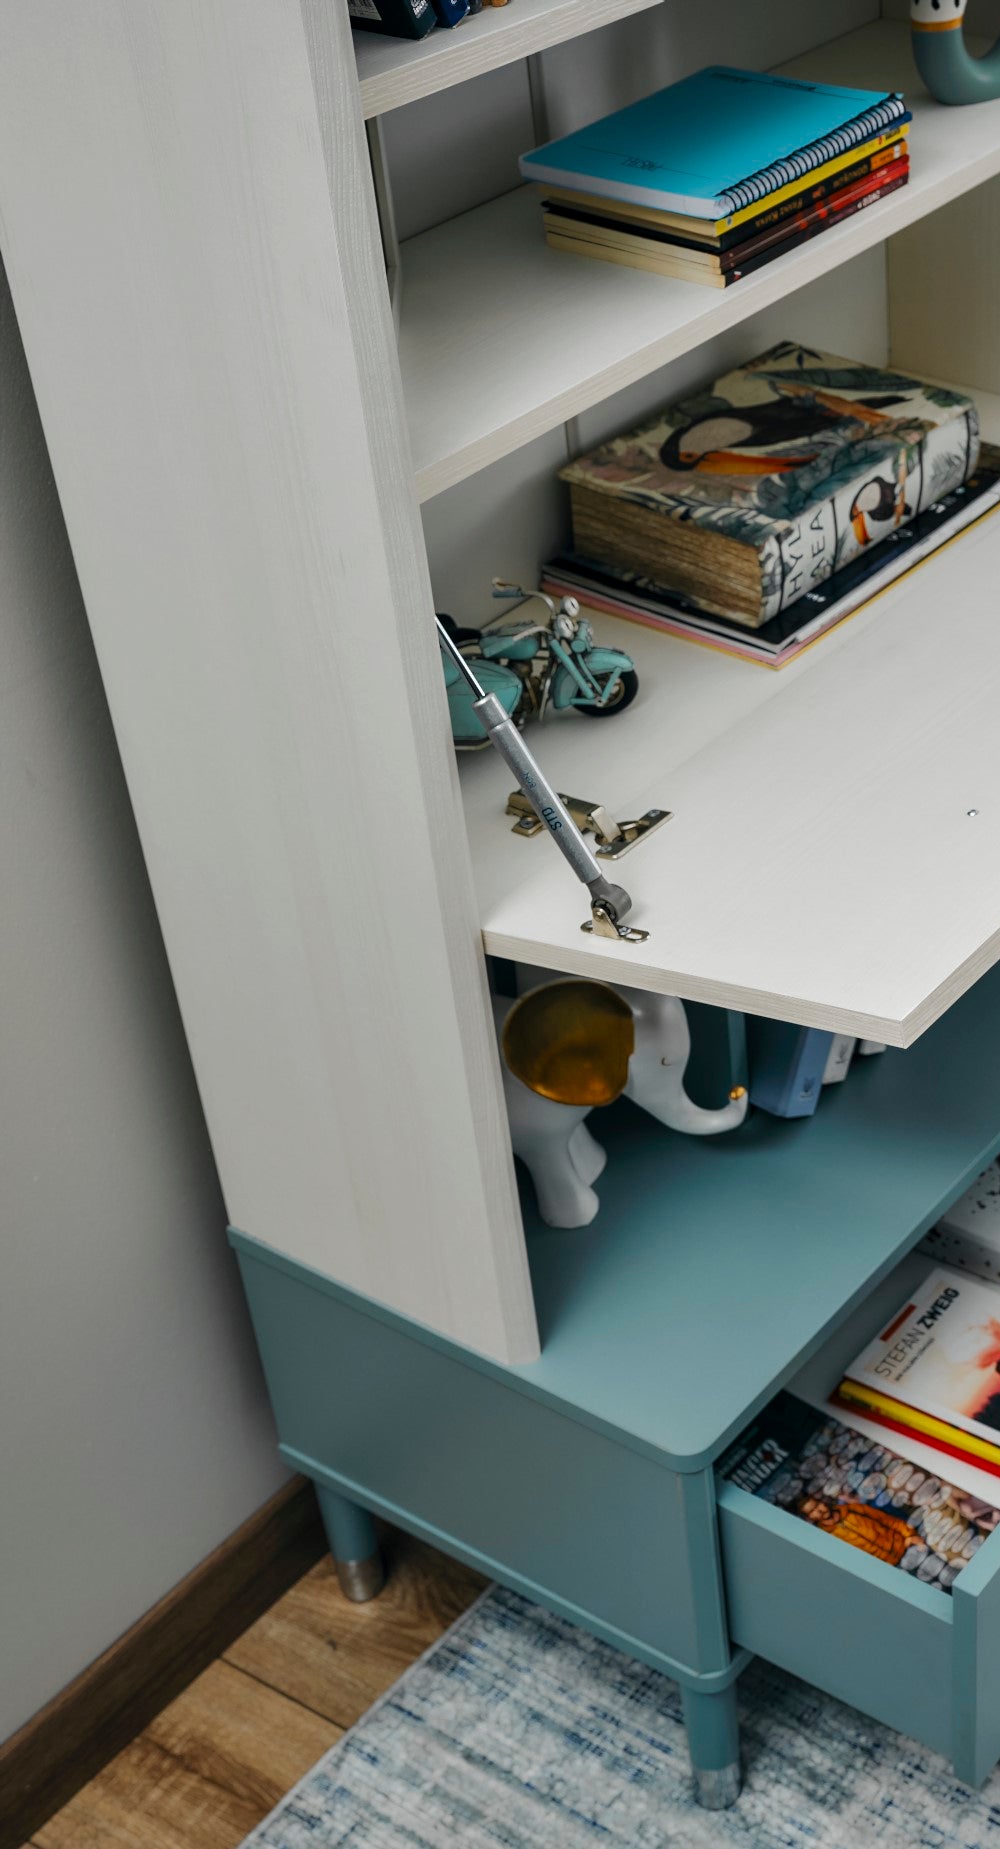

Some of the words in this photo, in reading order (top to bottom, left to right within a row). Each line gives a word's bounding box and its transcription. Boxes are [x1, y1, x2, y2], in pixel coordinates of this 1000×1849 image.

[541, 807, 562, 831] STD
[874, 1327, 926, 1377] STEFAN
[917, 1287, 960, 1330] ZWEIG
